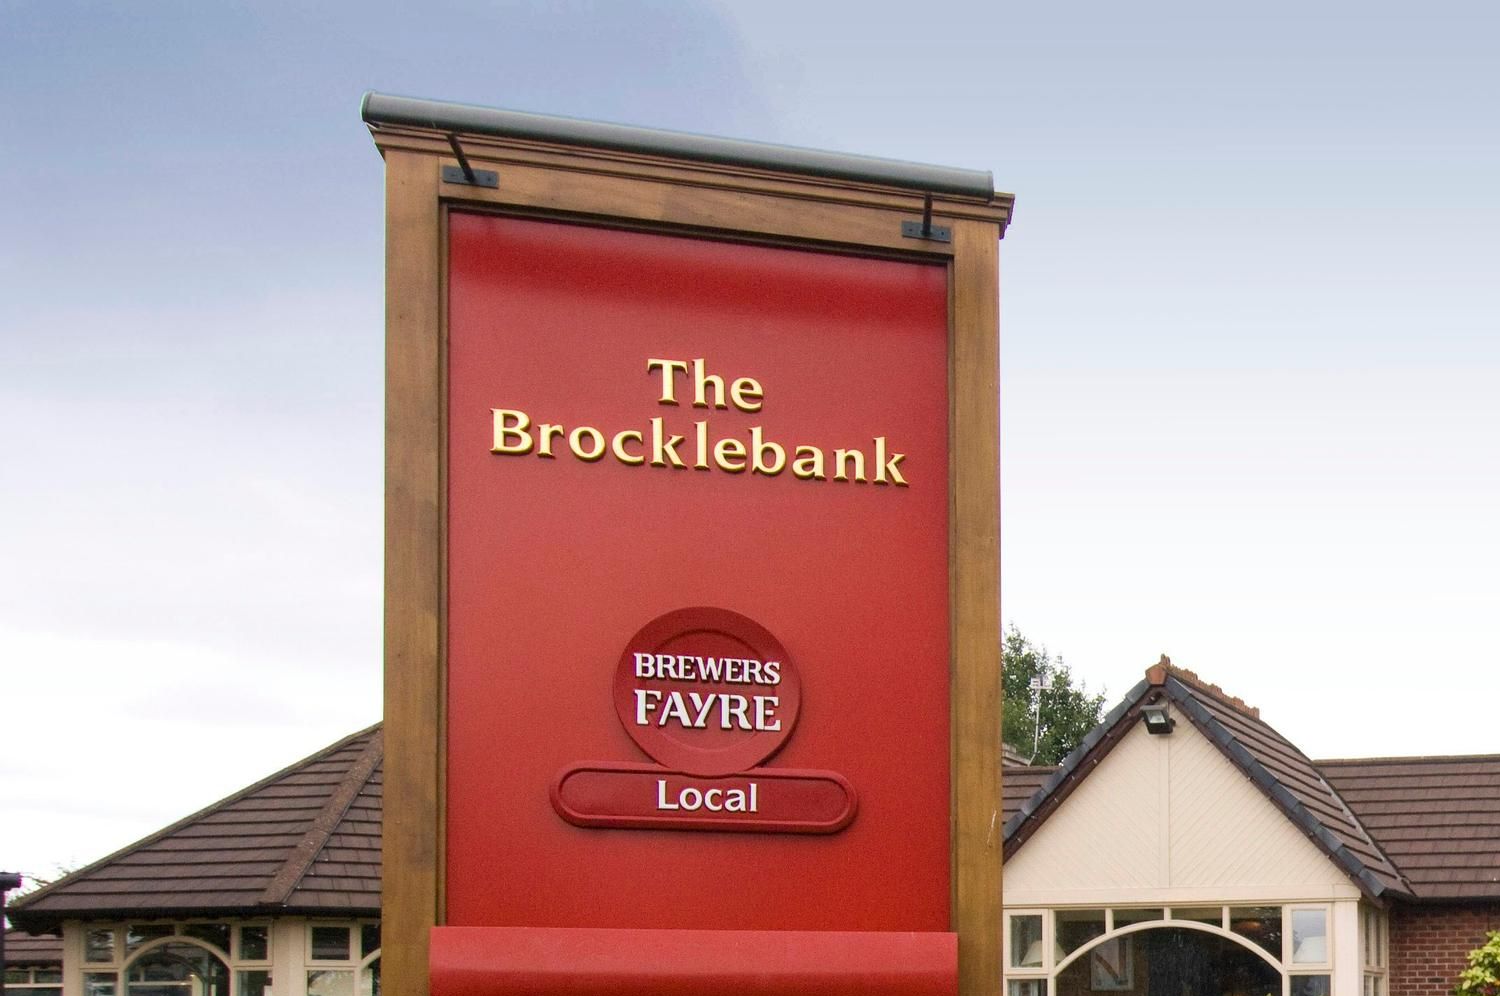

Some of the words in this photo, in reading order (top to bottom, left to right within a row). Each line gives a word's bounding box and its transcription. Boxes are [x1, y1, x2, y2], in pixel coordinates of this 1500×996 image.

[647, 357, 764, 412] The
[489, 407, 910, 487] Brocklebank
[633, 652, 782, 685] BREWERS
[633, 688, 783, 732] FAYRE
[656, 779, 760, 813] Local
